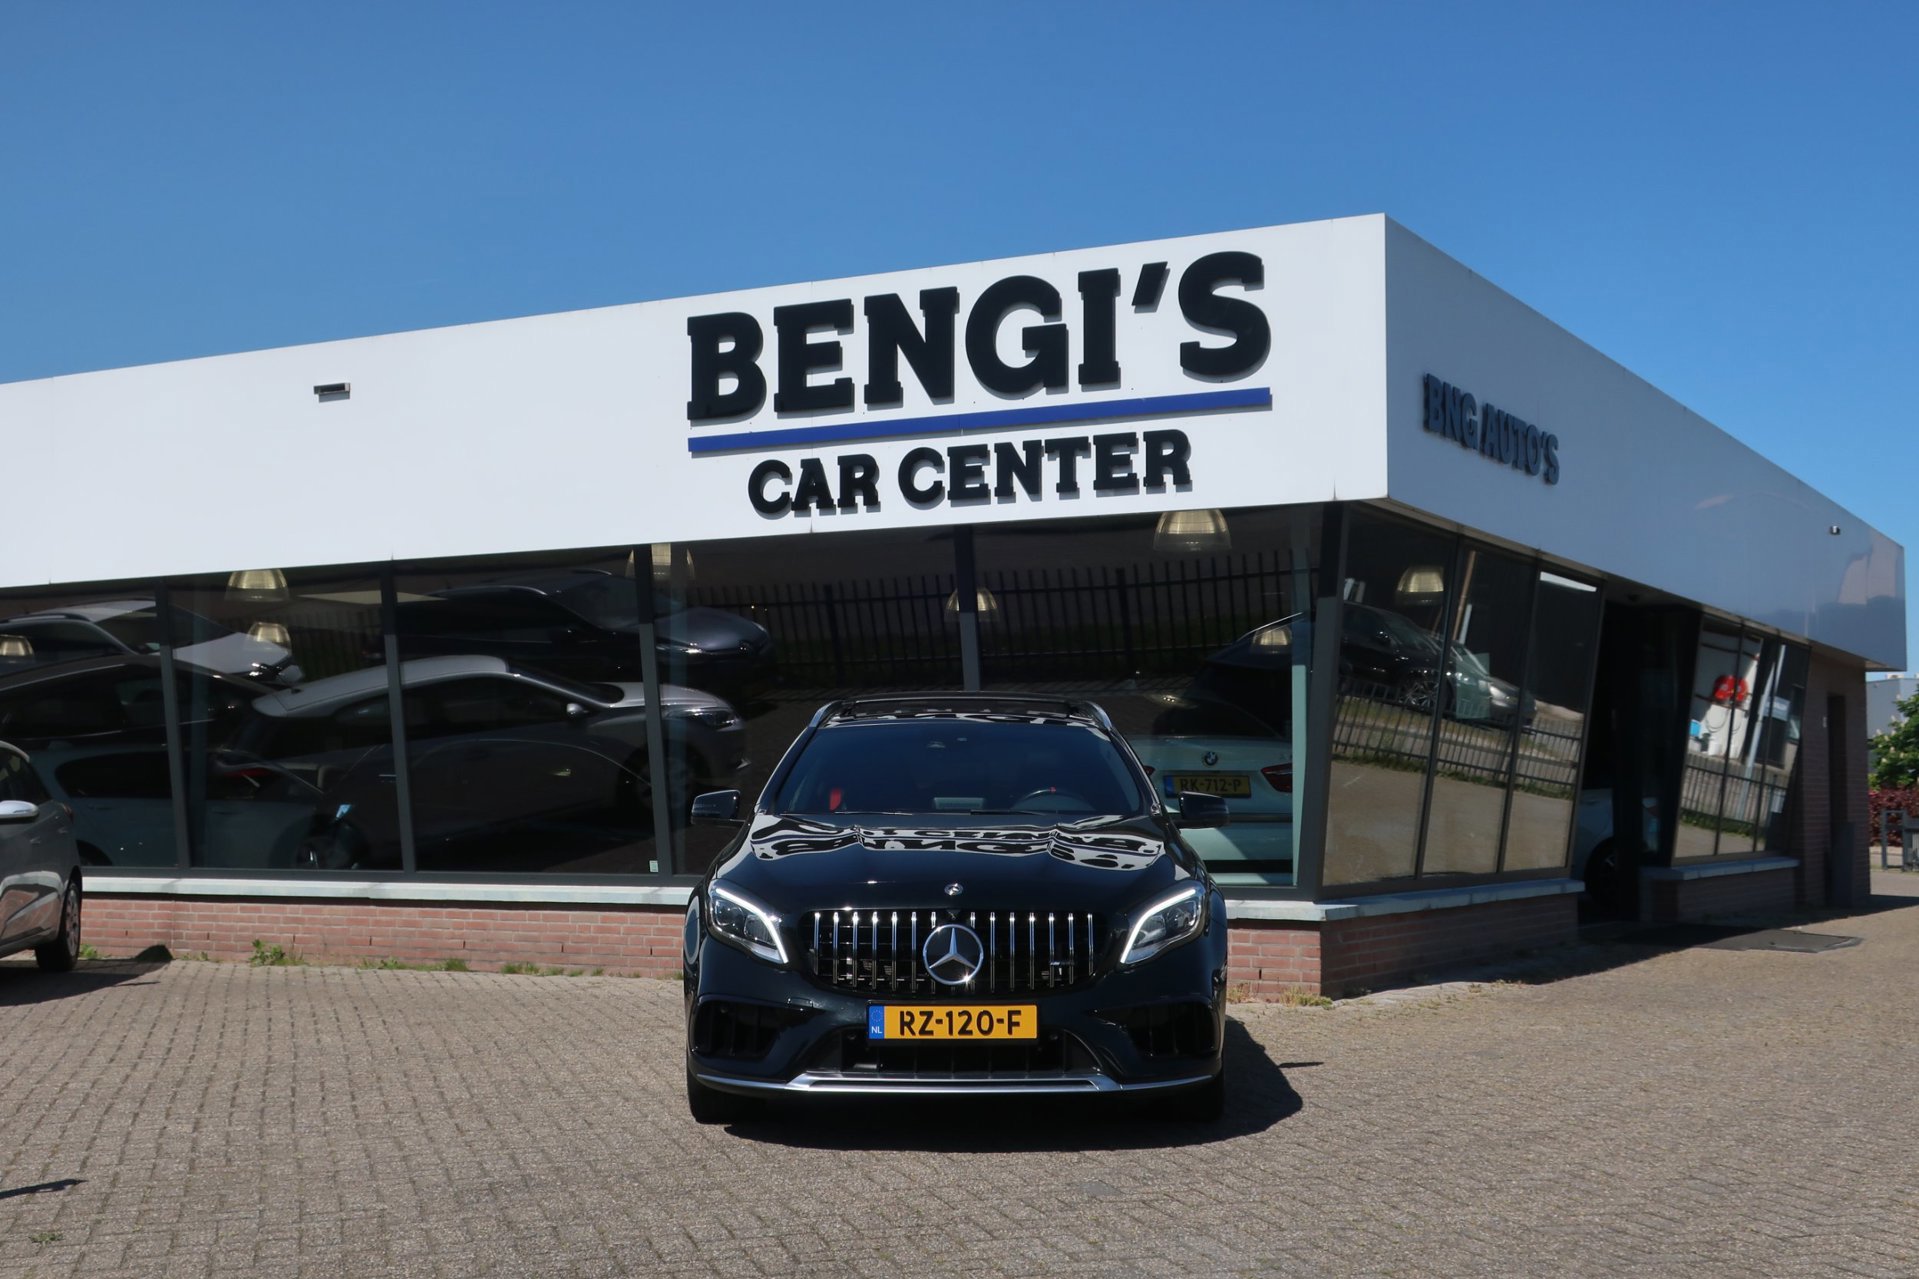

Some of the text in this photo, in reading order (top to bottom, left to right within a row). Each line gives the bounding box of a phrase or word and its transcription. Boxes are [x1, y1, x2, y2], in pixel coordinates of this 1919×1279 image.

[687, 250, 1271, 423] BENGI'S
[748, 429, 1191, 514] CAR CENTER
[1423, 373, 1560, 485] BNG AUTO'S
[871, 1009, 1022, 1036] NL RZ-120-F
